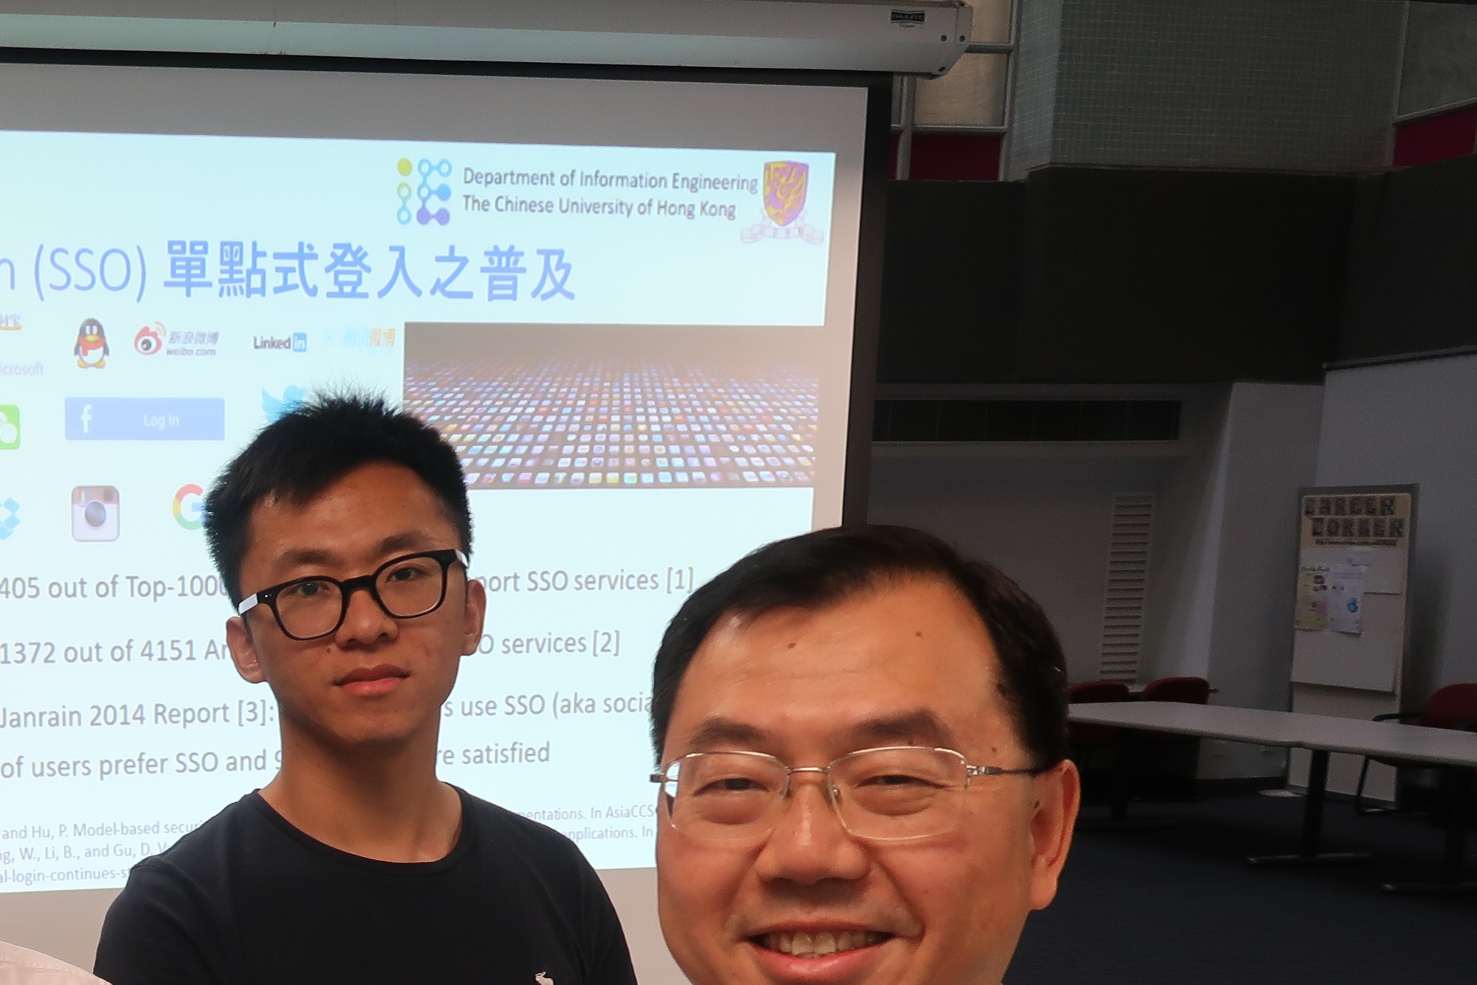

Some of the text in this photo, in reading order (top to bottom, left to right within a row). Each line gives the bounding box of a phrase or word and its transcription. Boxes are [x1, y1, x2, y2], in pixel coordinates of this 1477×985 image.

[463, 167, 759, 195] Department of Information Engineering
[463, 194, 736, 220] The Chinese University of Hong Kong
[34, 243, 147, 302] (SSO)
[164, 240, 575, 301] 單點式登入之普及
[166, 347, 216, 357] weibo.com
[144, 413, 165, 430] Log
[48, 577, 88, 599] out
[94, 574, 121, 598] of
[526, 570, 569, 592] SSO
[574, 566, 659, 591] services
[665, 567, 695, 594] [1]
[0, 641, 55, 665] 1372
[63, 642, 103, 663] out
[108, 639, 134, 663] of
[139, 638, 197, 662] 4151
[501, 630, 587, 655] services
[592, 630, 621, 656] [2]
[0, 703, 82, 729] Janrain
[88, 703, 146, 726] 2014
[153, 700, 230, 729] Report
[238, 699, 274, 726] [3]:
[460, 696, 498, 717] use
[504, 693, 545, 717] SSO
[553, 691, 597, 719] (aka
[602, 690, 653, 716] socia
[0, 753, 25, 778] of
[31, 755, 92, 777] users
[99, 753, 169, 781] prefer
[174, 751, 218, 774] SSO
[225, 747, 267, 772] and
[461, 741, 551, 766] satisfied
[2, 825, 28, 840] and
[32, 824, 54, 840] Hu,
[59, 824, 69, 837] P.
[73, 820, 160, 838] Model-based
[590, 806, 602, 819] In
[19, 846, 38, 862] W.,
[45, 845, 59, 861] Li,
[63, 844, 80, 859] B.,
[84, 843, 109, 858] and
[113, 842, 133, 859] Gu,
[642, 826, 653, 837] In
